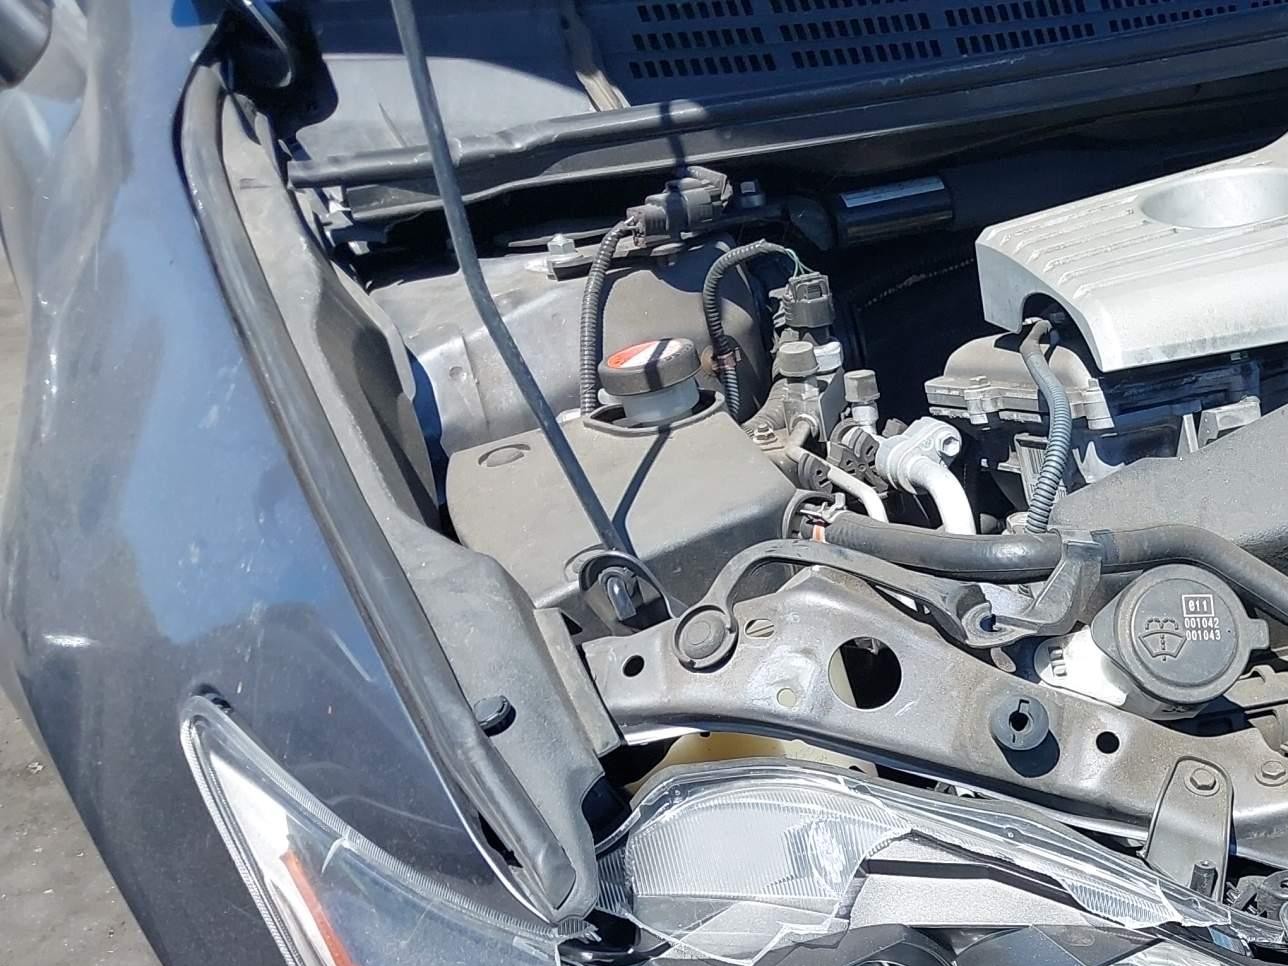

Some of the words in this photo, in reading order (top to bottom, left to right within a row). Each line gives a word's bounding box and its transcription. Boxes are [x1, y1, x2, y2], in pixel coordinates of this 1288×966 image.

[1188, 599, 1208, 612] e11
[1184, 617, 1220, 629] 001042
[1185, 629, 1221, 641] 001043
